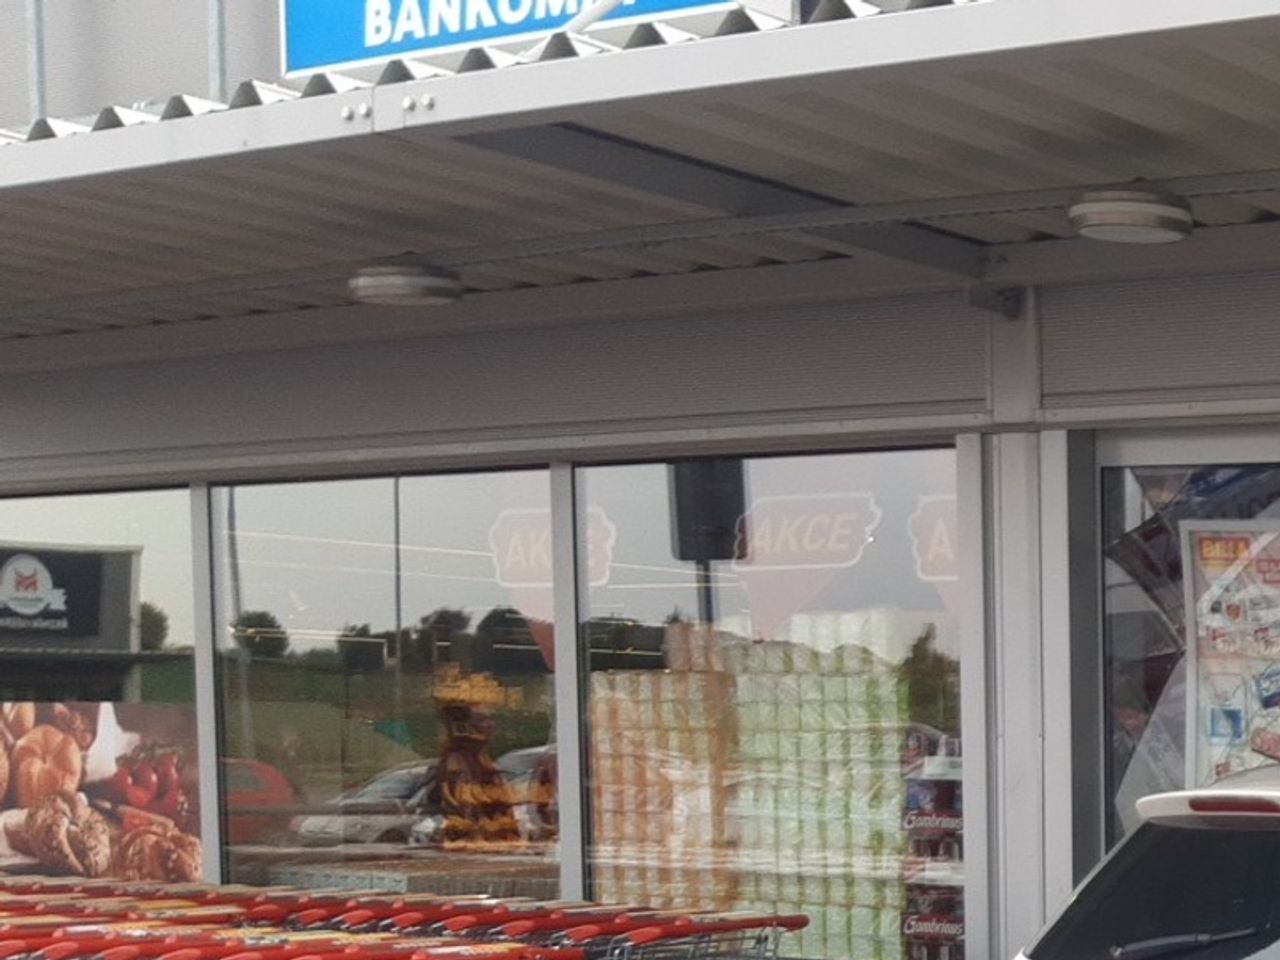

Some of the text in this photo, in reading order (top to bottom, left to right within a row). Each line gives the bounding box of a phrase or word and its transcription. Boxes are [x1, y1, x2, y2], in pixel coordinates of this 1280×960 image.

[365, 0, 635, 47] BANKO
[750, 511, 859, 553] AKCE
[904, 914, 963, 934] Gambrinus
